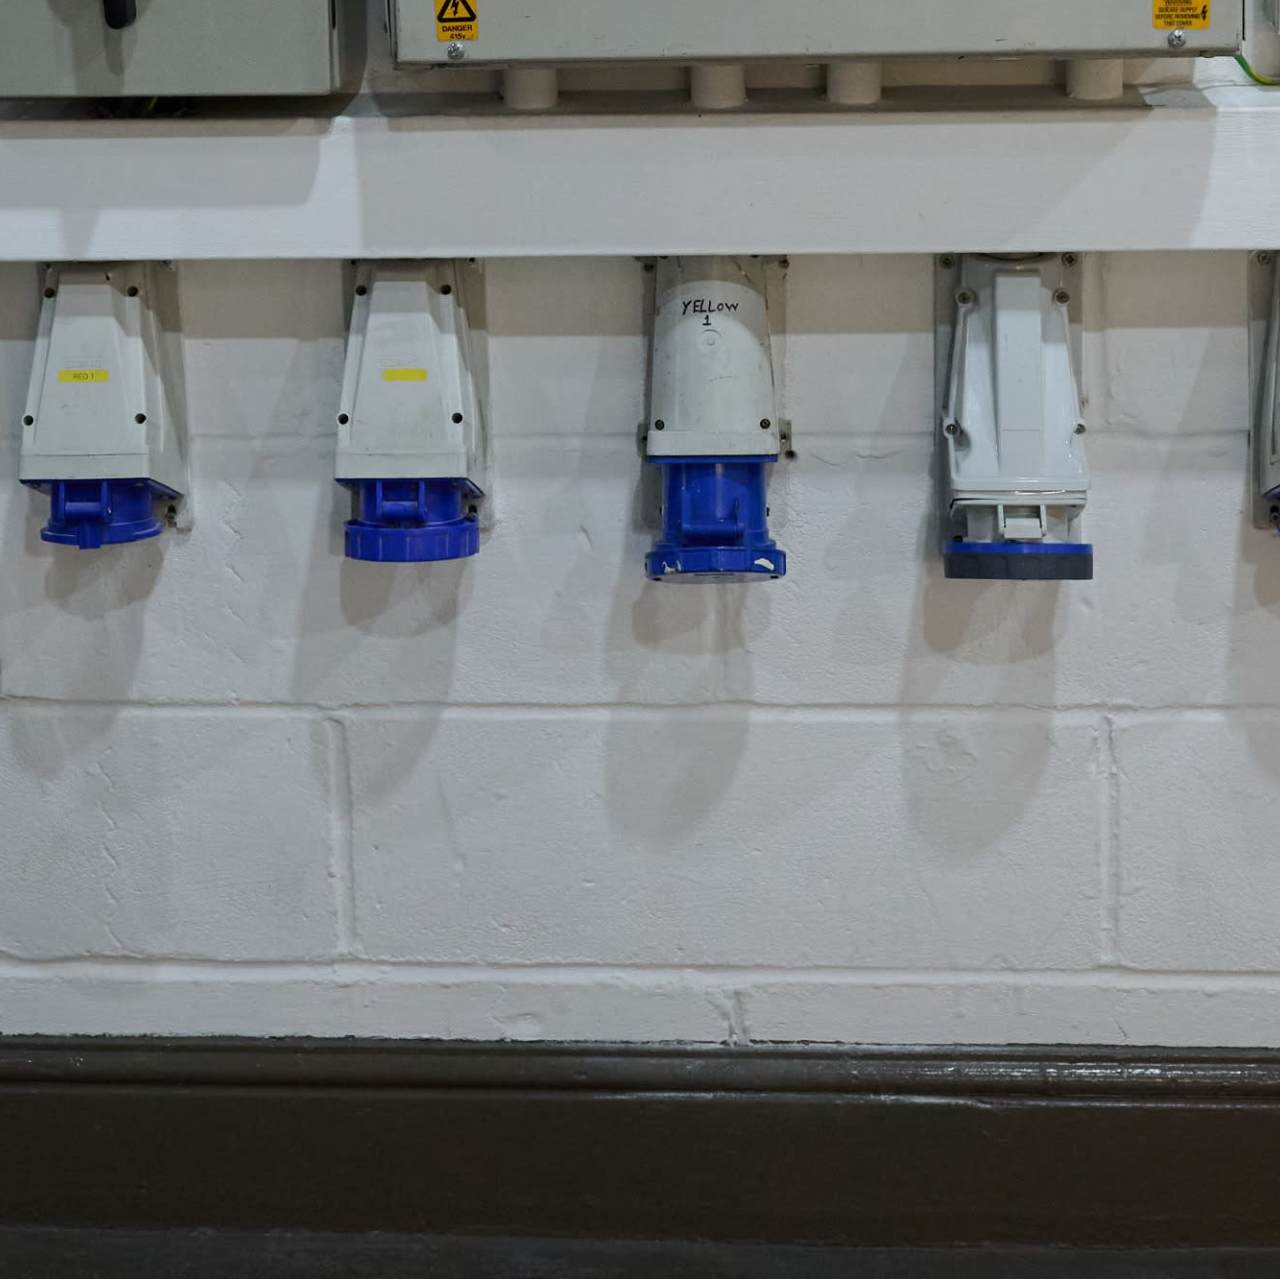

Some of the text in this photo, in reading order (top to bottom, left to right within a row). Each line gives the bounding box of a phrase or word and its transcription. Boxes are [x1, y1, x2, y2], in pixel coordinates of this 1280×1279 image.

[441, 24, 473, 32] DANGER
[682, 298, 739, 315] YELLOW
[702, 314, 712, 326] 1
